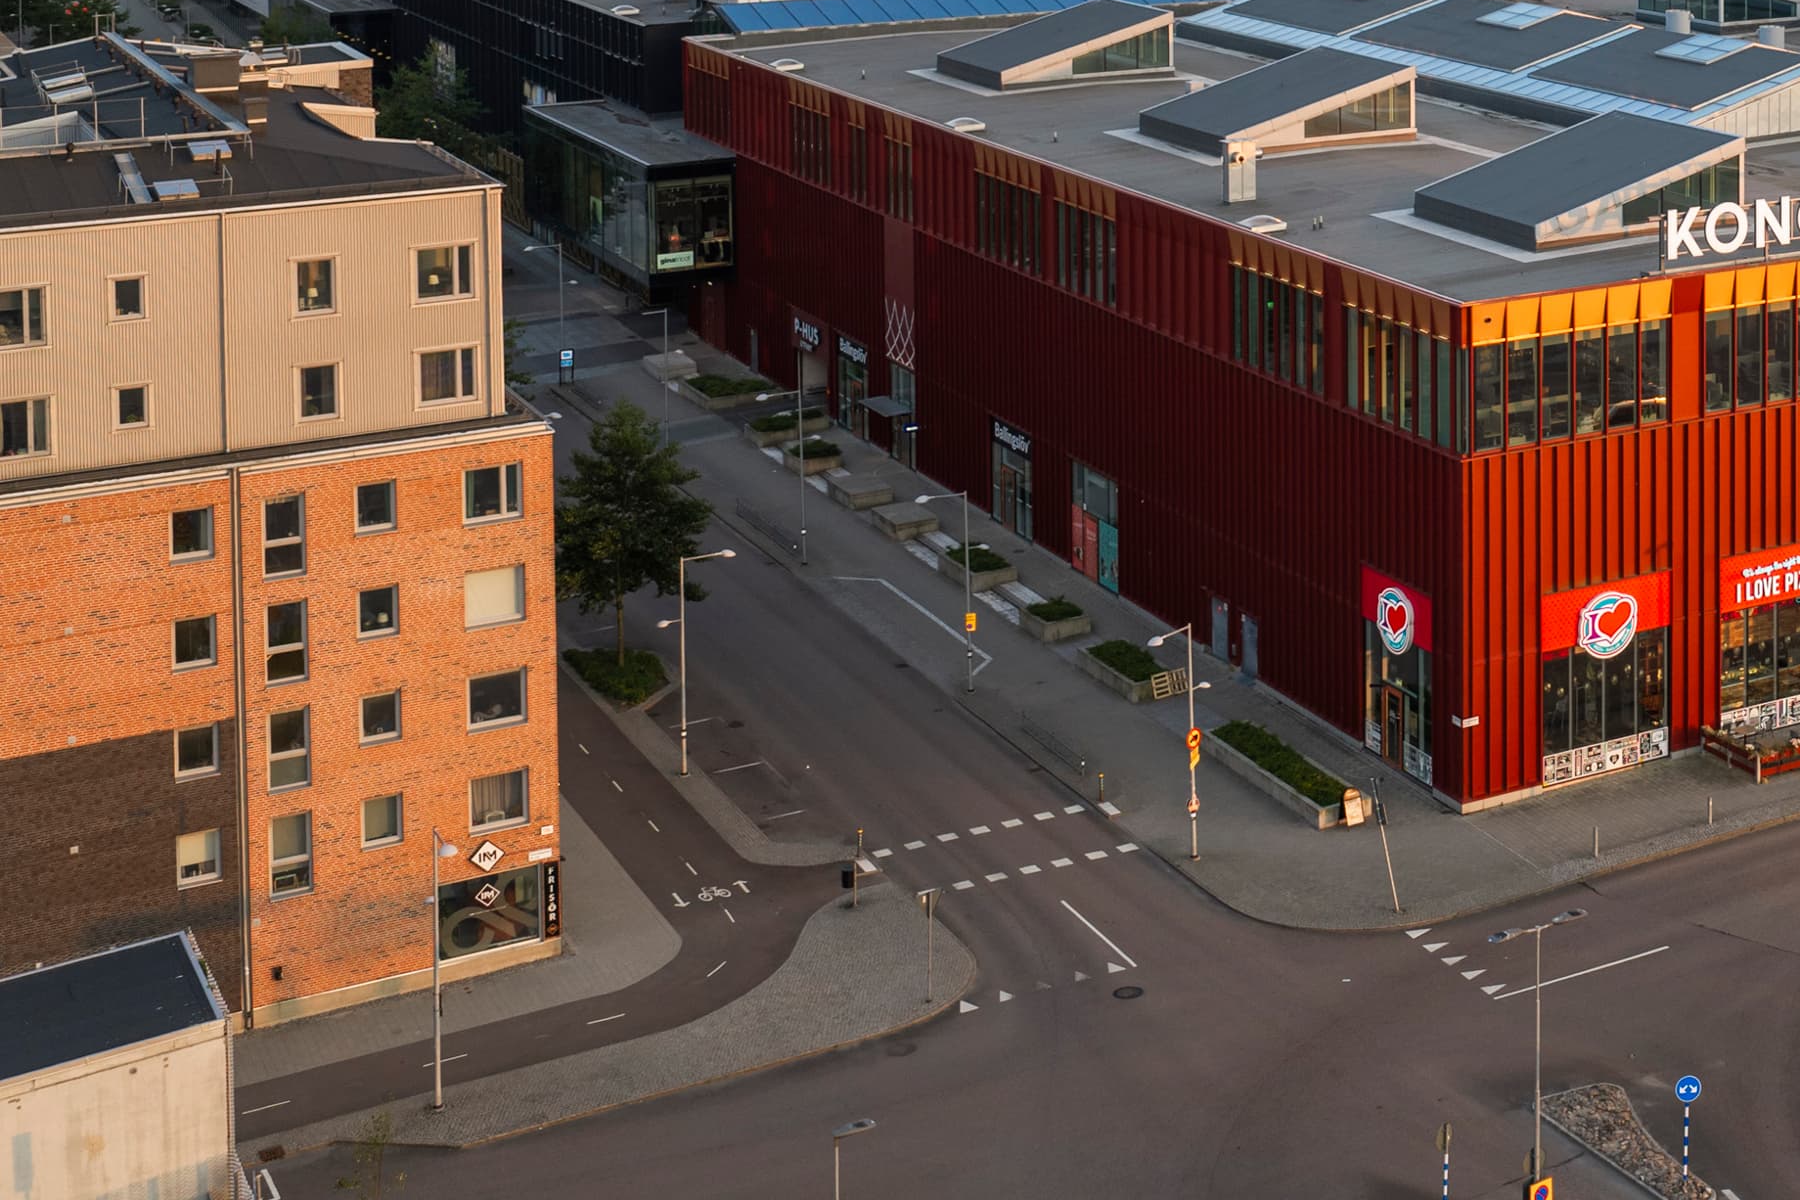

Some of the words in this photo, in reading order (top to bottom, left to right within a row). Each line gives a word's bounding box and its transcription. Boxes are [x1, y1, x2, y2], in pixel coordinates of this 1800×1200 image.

[1736, 583, 1742, 604] I
[1745, 575, 1780, 602] LOVE
[548, 866, 557, 921] FRISÖR
